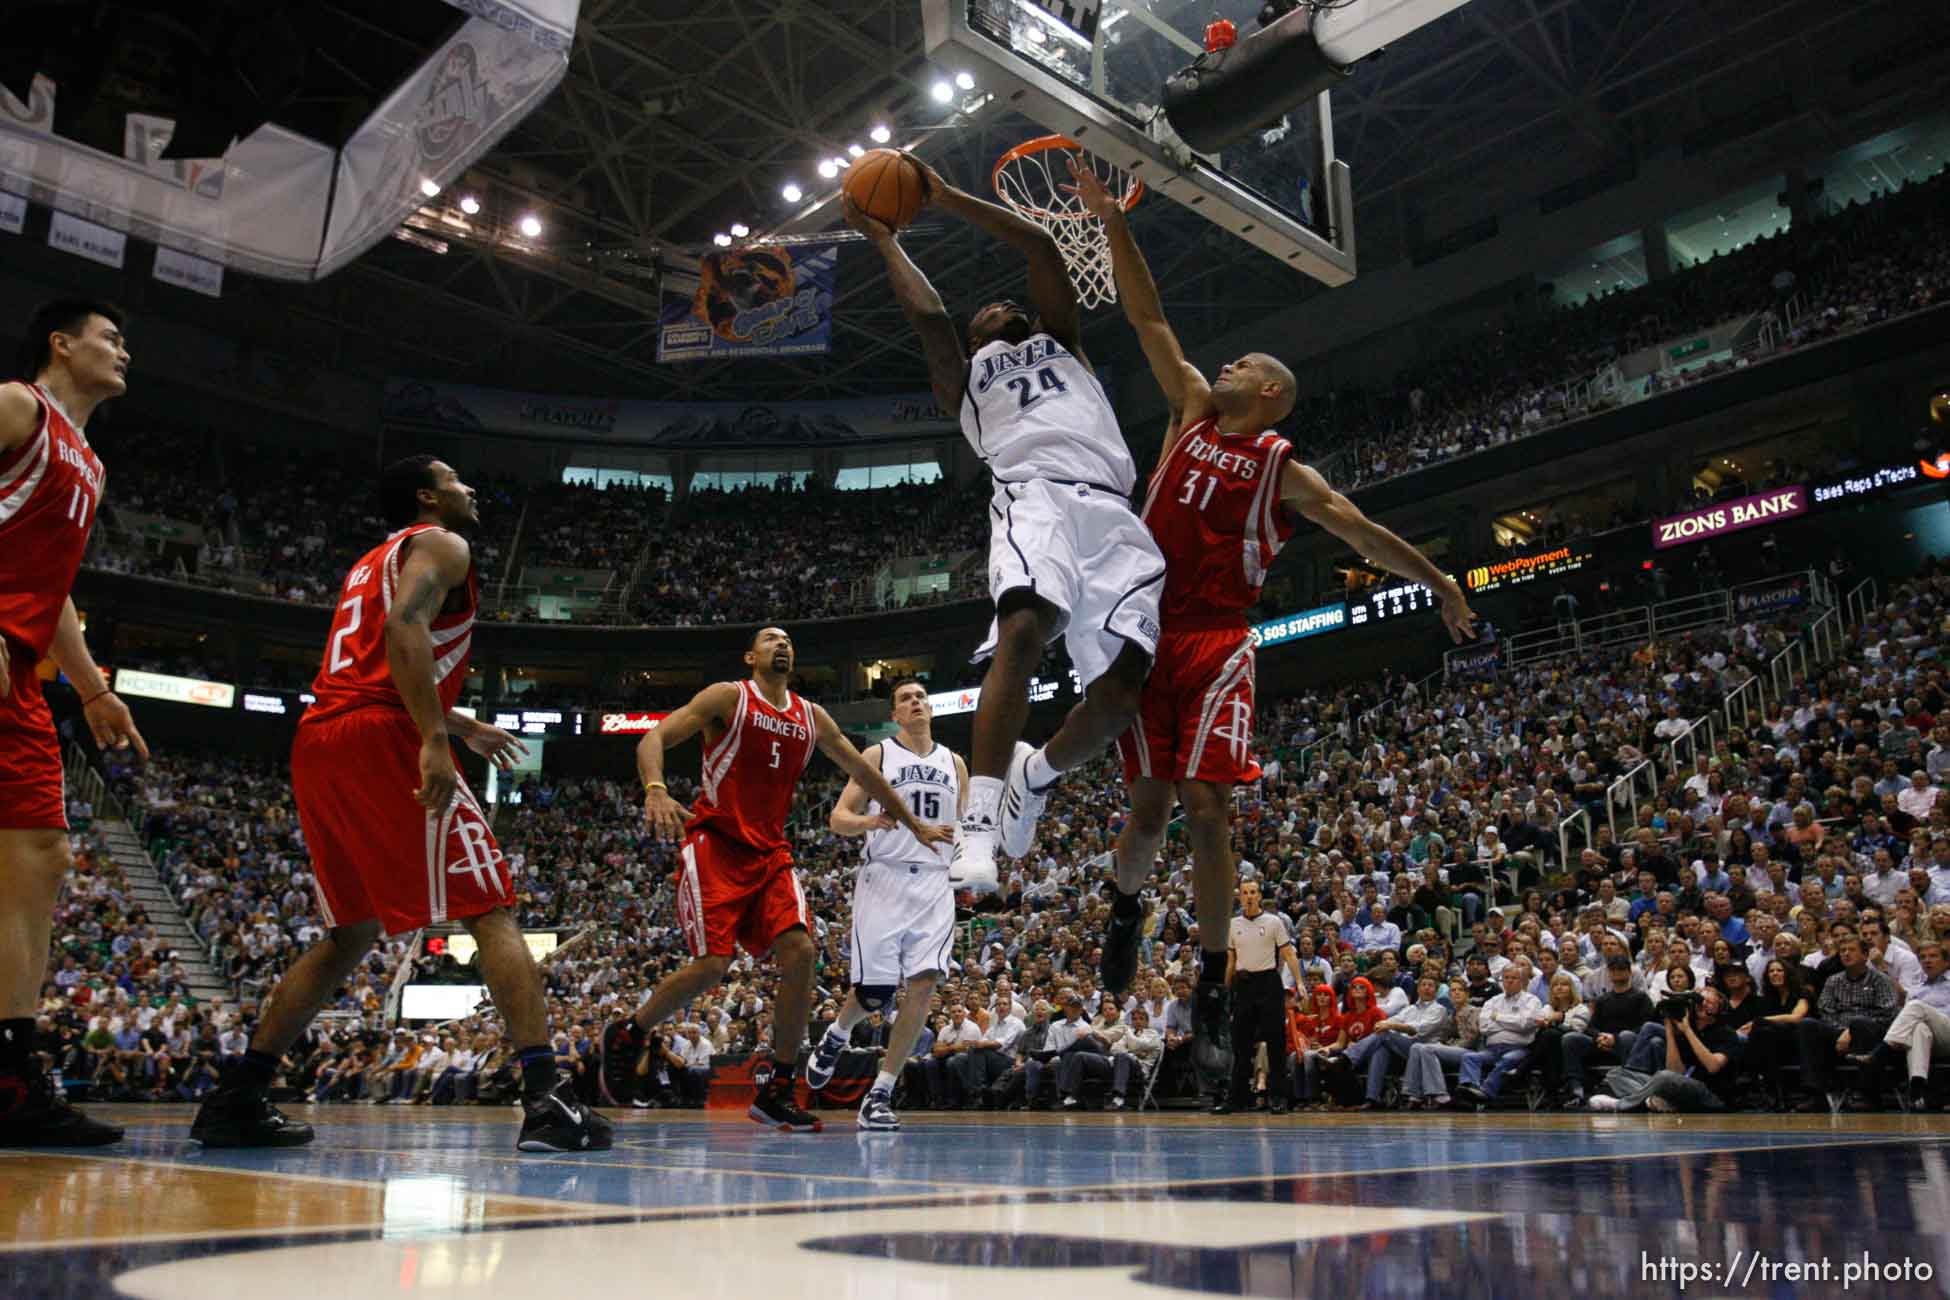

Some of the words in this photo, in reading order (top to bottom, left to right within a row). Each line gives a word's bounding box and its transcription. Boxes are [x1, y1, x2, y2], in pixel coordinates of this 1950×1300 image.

[1007, 367, 1067, 408] 24
[68, 484, 89, 528] 11
[1179, 469, 1218, 511] 31
[1814, 483, 1844, 502] Sales
[1845, 478, 1873, 496] Reps
[1660, 510, 1727, 542] ZIONS
[1732, 492, 1798, 524] BANK
[1489, 547, 1571, 576] WebPayment
[330, 595, 363, 674] 2
[1264, 624, 1287, 641] SOS
[1289, 609, 1344, 635] STAFFING
[753, 710, 807, 741] ROCKETS
[769, 741, 781, 768] 5
[911, 793, 940, 819] 15
